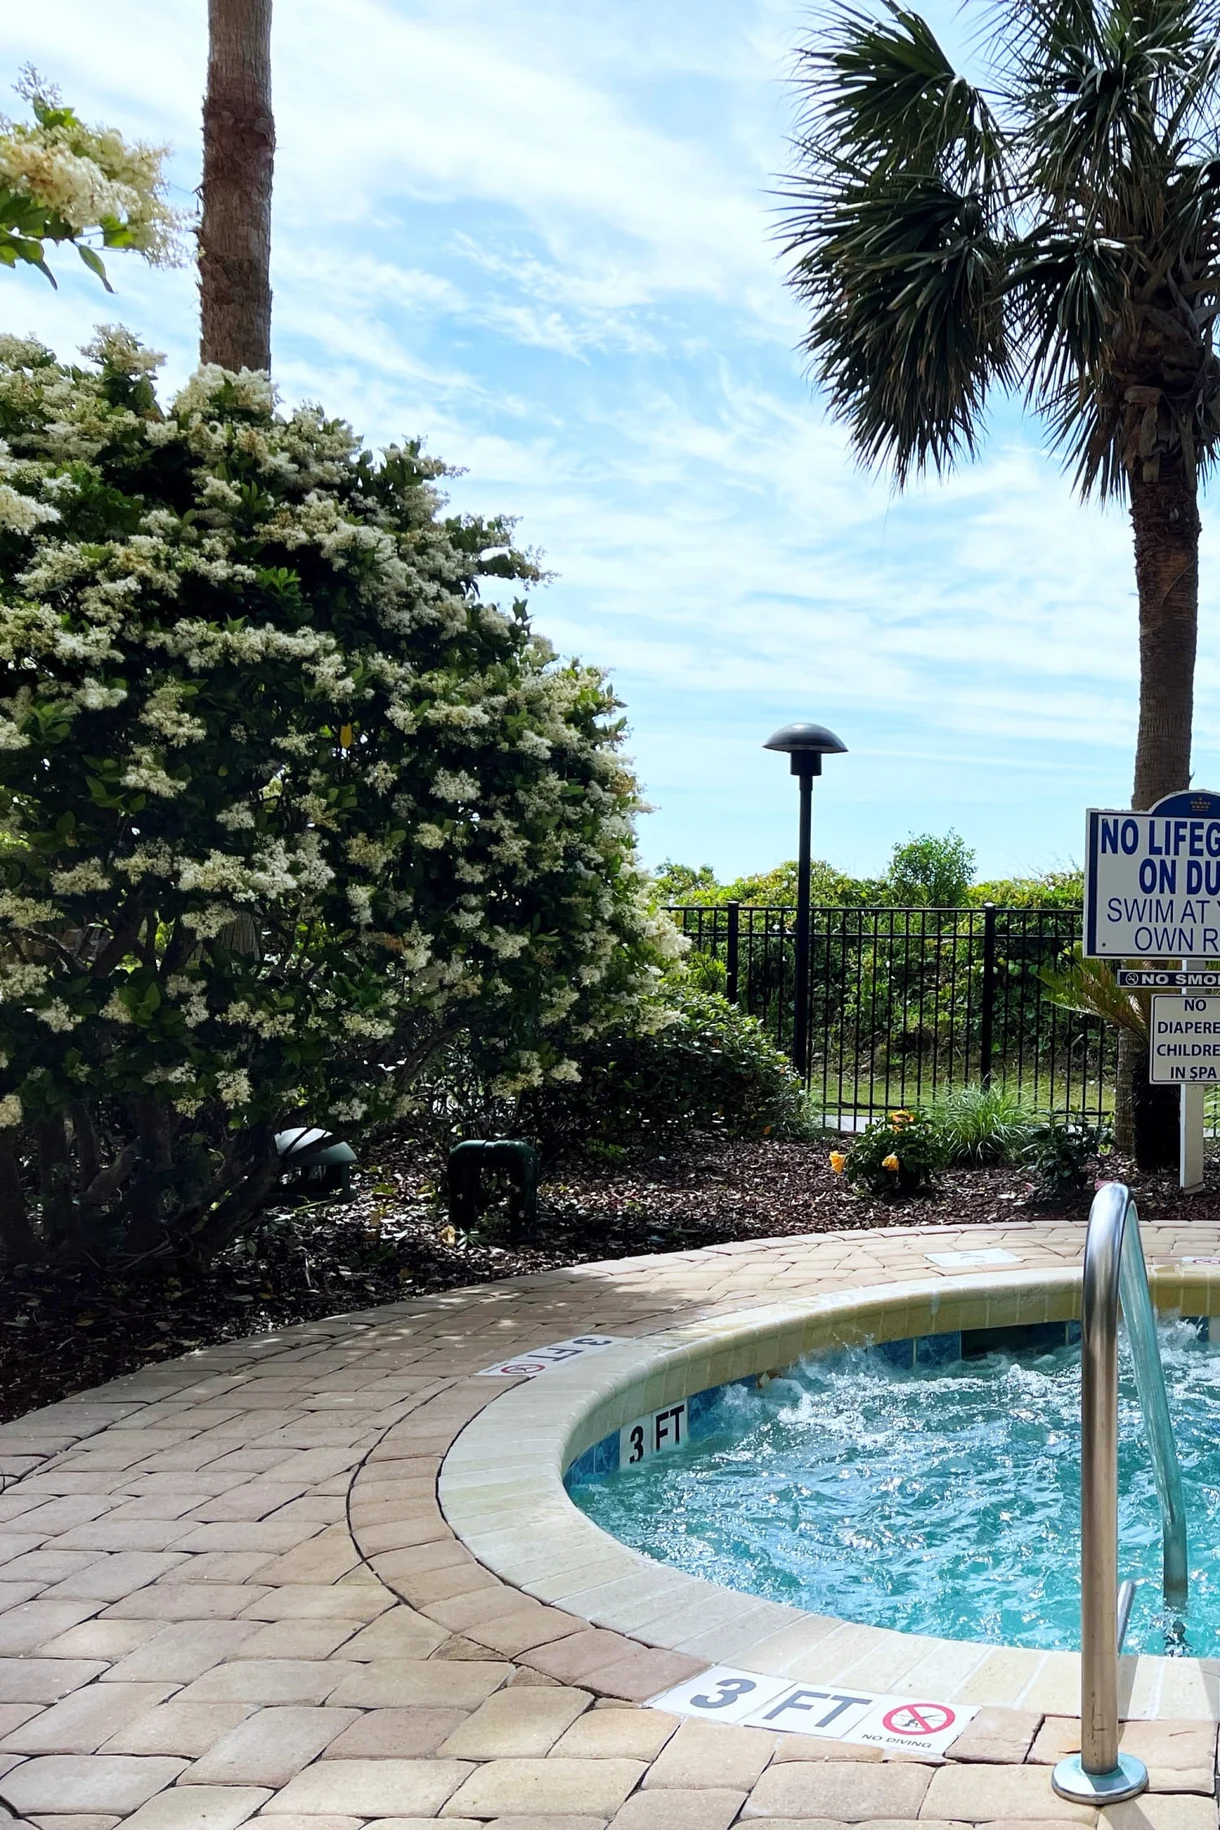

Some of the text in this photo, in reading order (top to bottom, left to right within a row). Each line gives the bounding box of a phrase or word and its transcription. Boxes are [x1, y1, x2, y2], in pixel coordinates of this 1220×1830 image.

[1102, 819, 1138, 855] NO
[1139, 859, 1176, 894] ON
[1107, 898, 1173, 924] SWIM
[1181, 900, 1210, 924] AT
[1135, 927, 1193, 951] OWN
[1142, 974, 1168, 984] NO
[1184, 999, 1206, 1011] NO
[1170, 1067, 1217, 1079] IN SPA
[527, 1338, 612, 1362] 3 FT
[629, 1404, 685, 1464] 3 FT
[690, 1678, 873, 1728] 3 FT
[886, 1738, 931, 1748] DIVING
